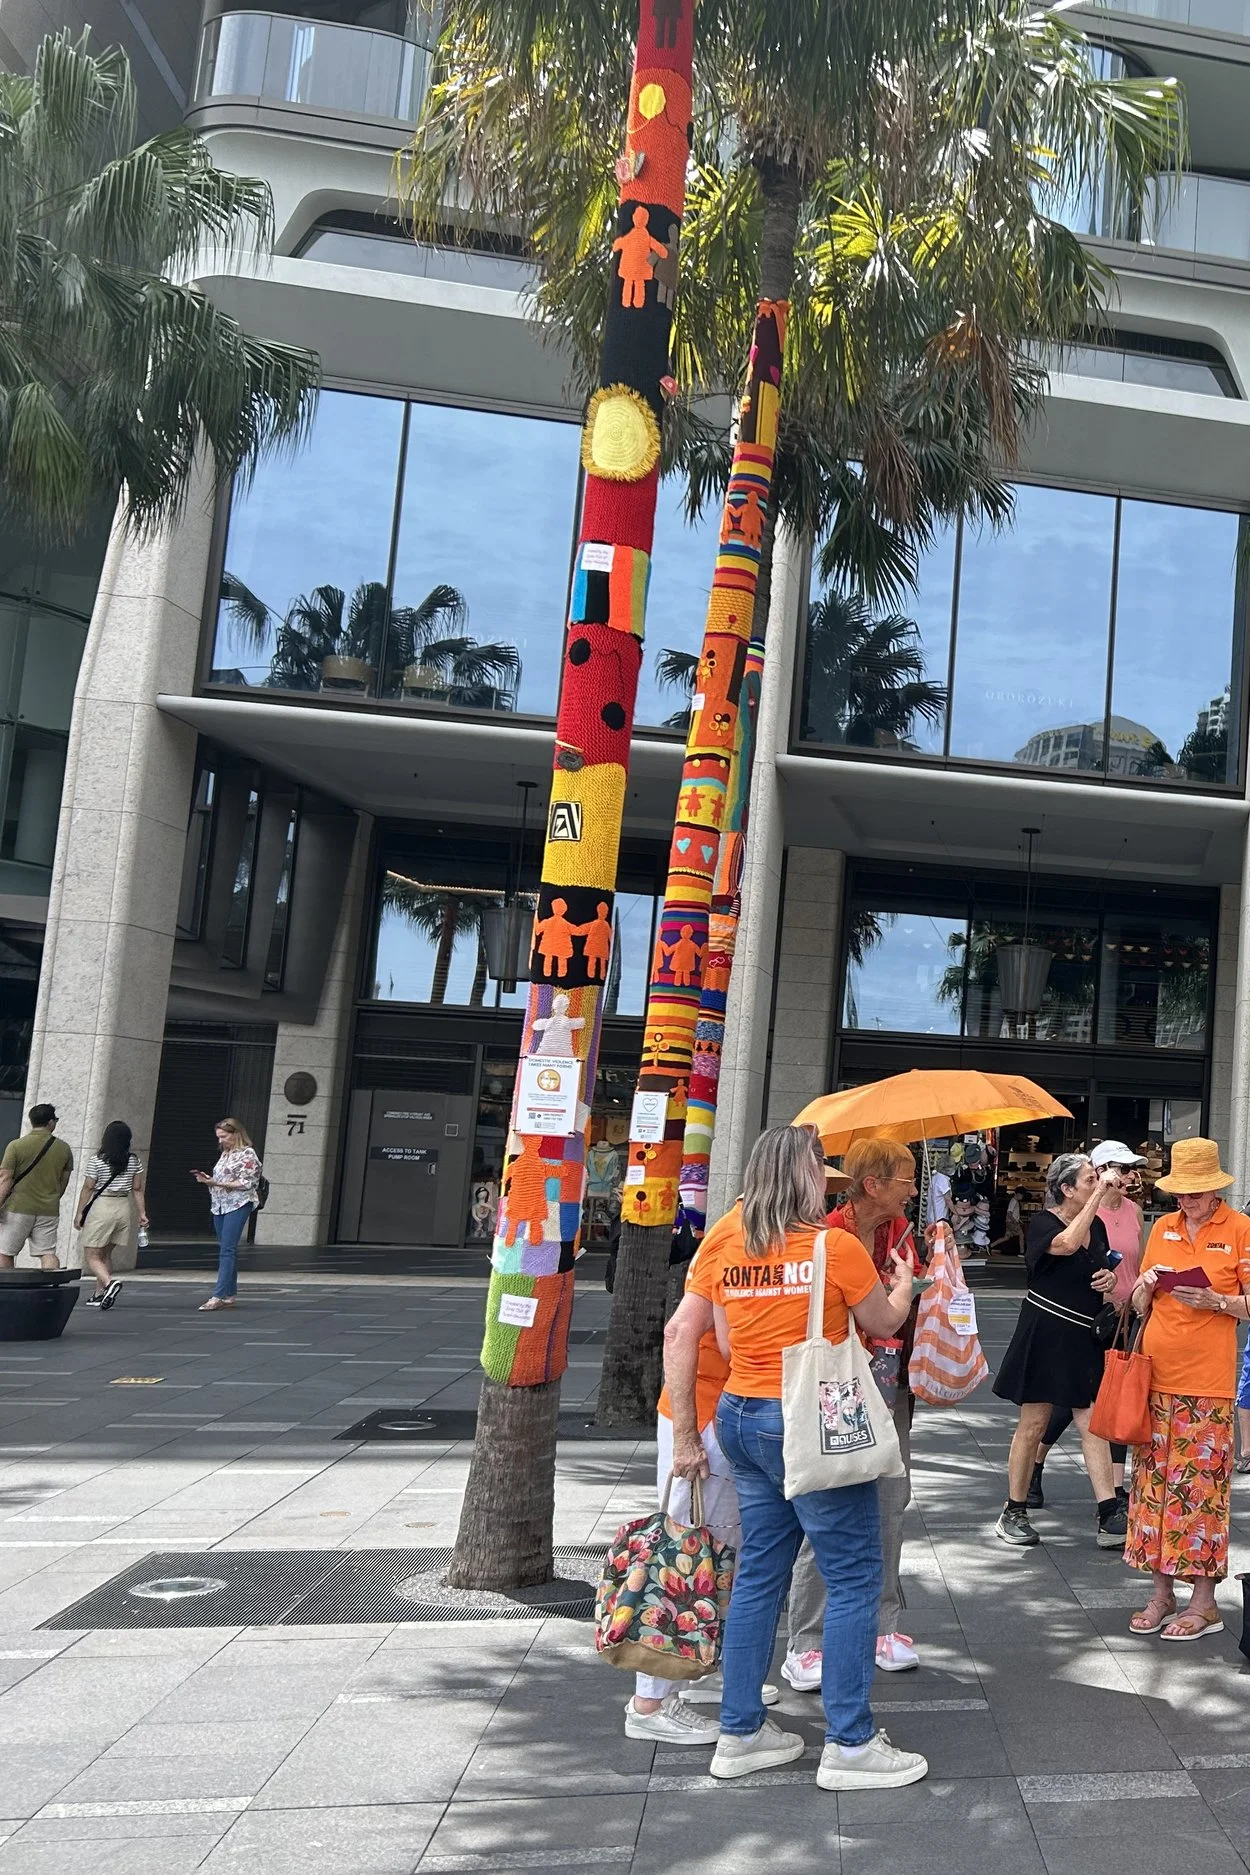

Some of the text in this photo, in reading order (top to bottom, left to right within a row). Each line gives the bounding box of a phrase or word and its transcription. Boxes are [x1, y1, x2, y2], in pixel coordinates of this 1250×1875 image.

[287, 1121, 305, 1136] 71
[722, 1260, 814, 1287] ZONTA SAYS NO
[755, 1287, 781, 1297] AGAINST
